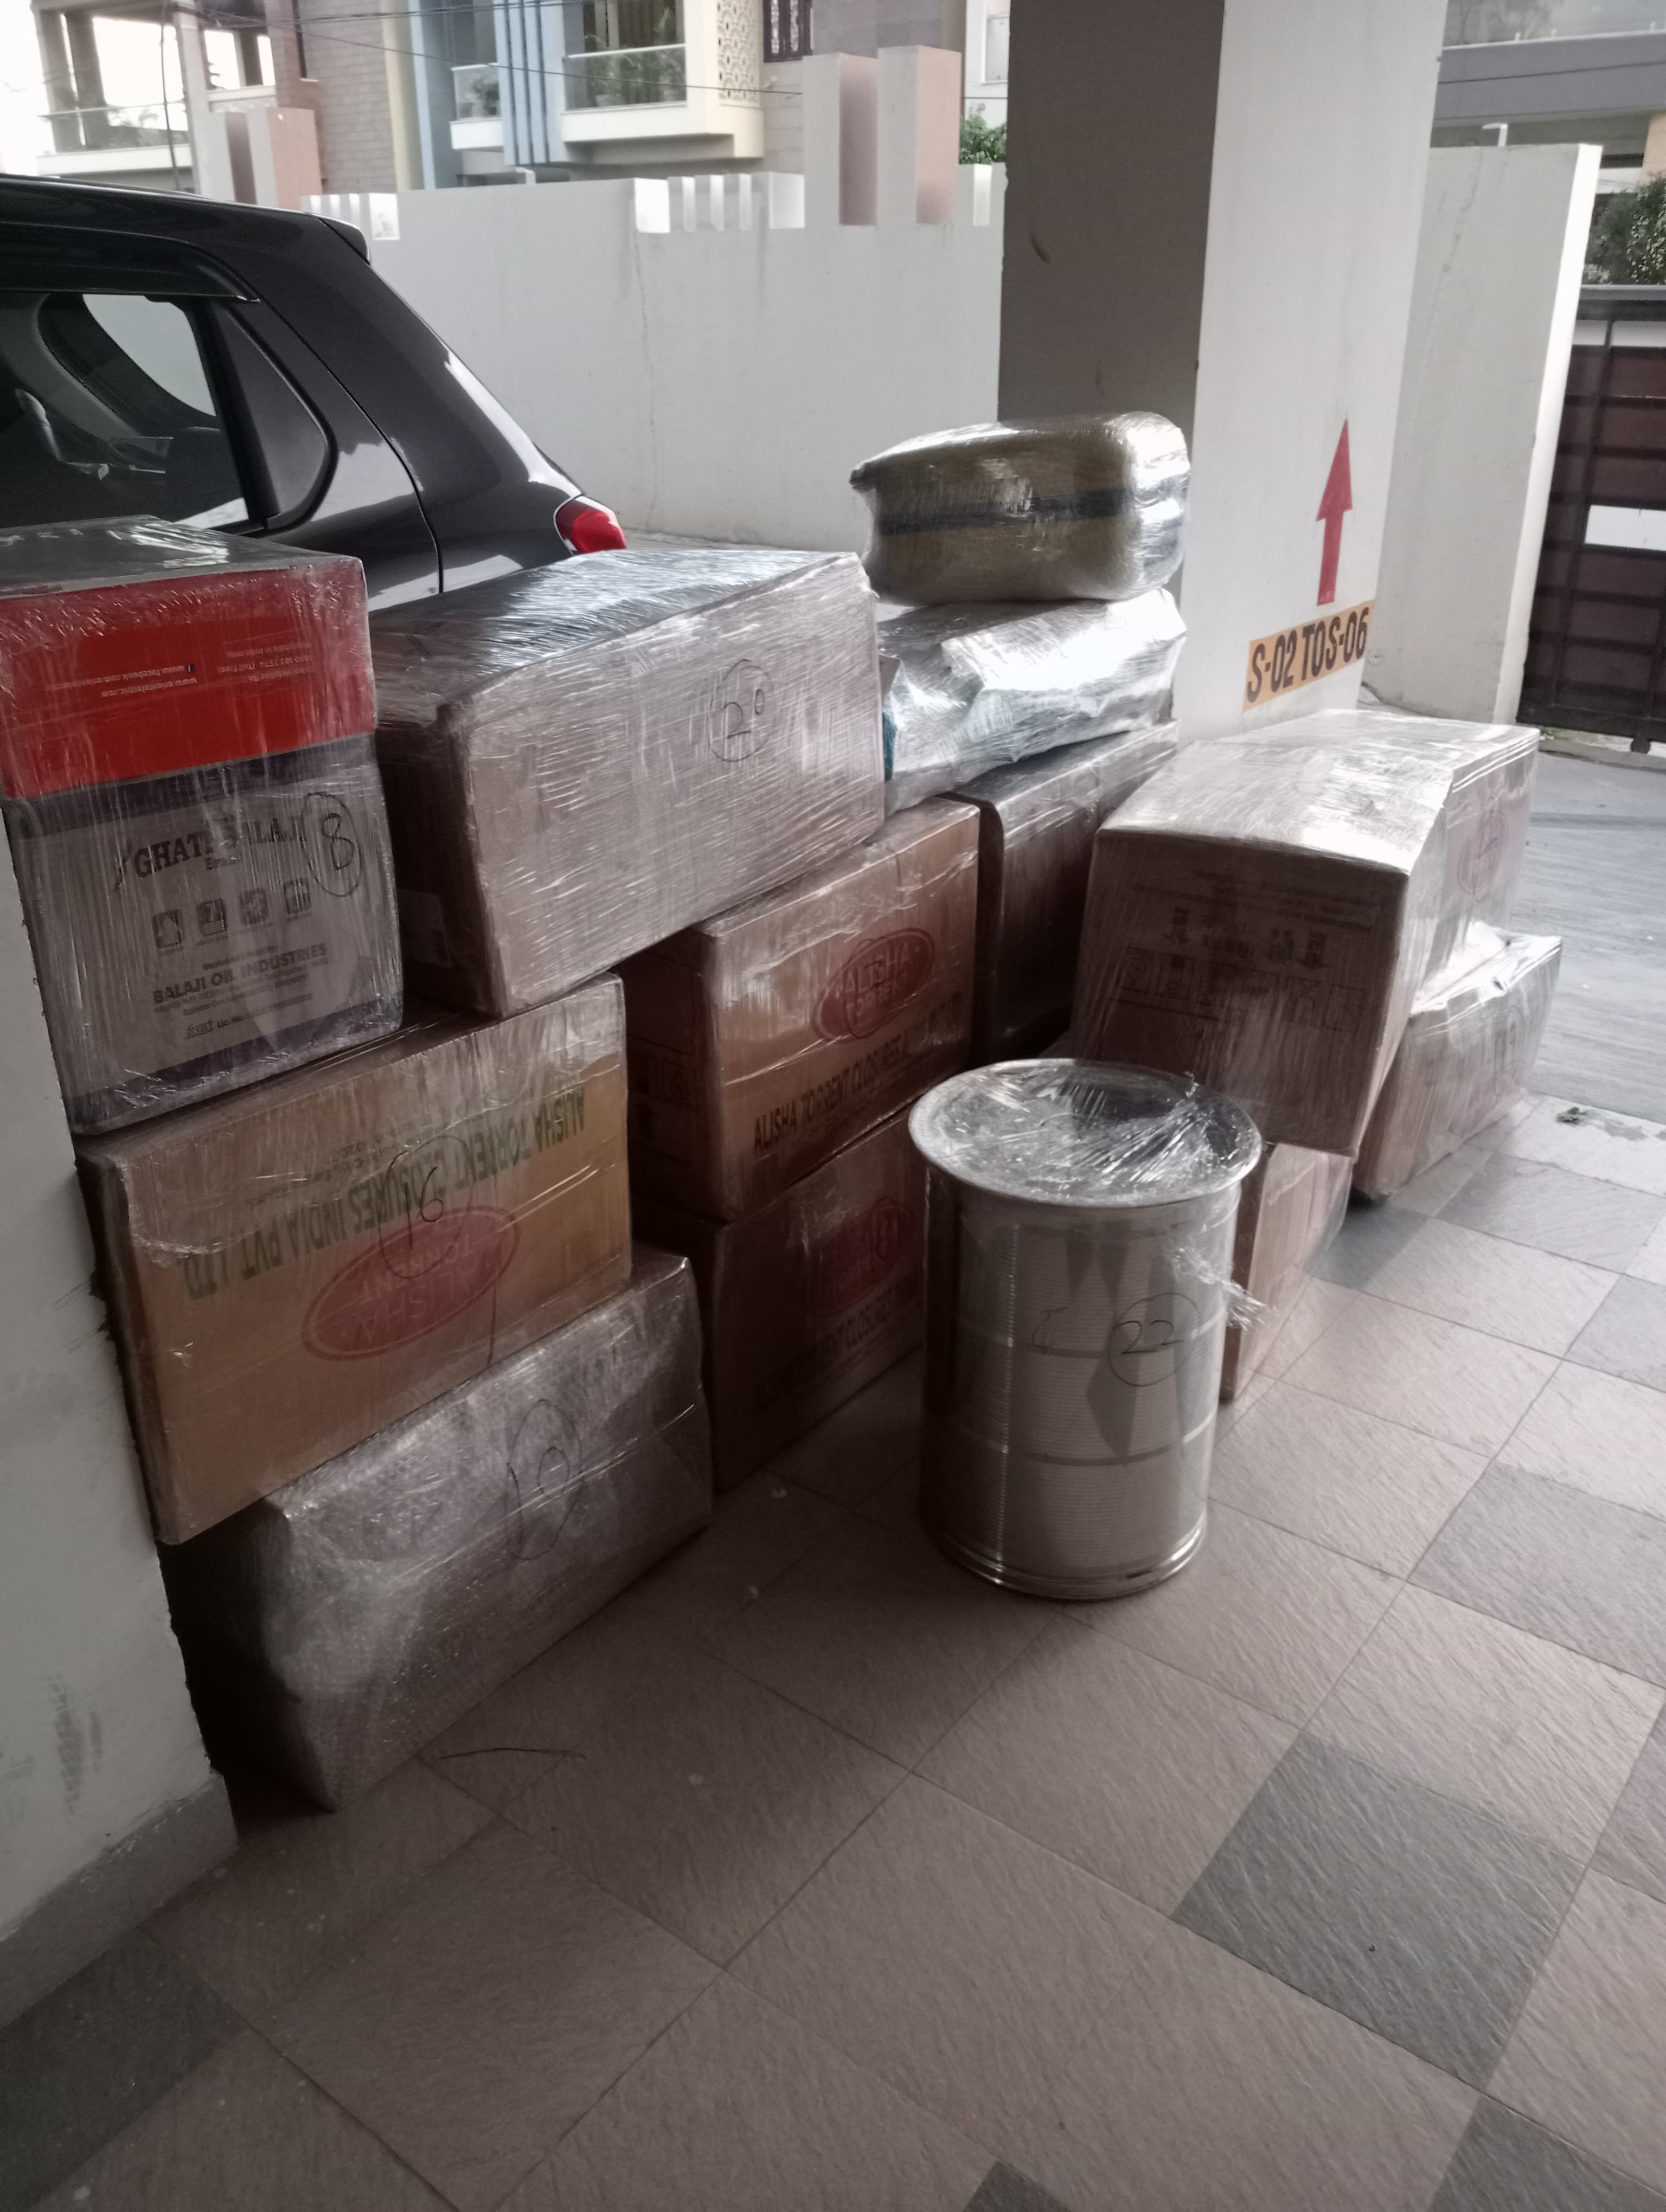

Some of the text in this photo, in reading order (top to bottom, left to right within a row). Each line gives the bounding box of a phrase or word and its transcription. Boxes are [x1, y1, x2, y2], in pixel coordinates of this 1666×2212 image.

[321, 813, 356, 871] 8
[152, 975, 206, 1005] BALAJI
[533, 1086, 586, 1153] ALISHA
[754, 1098, 798, 1153] ALISHA
[285, 1201, 347, 1253] INDIA
[1112, 1320, 1184, 1355] 22
